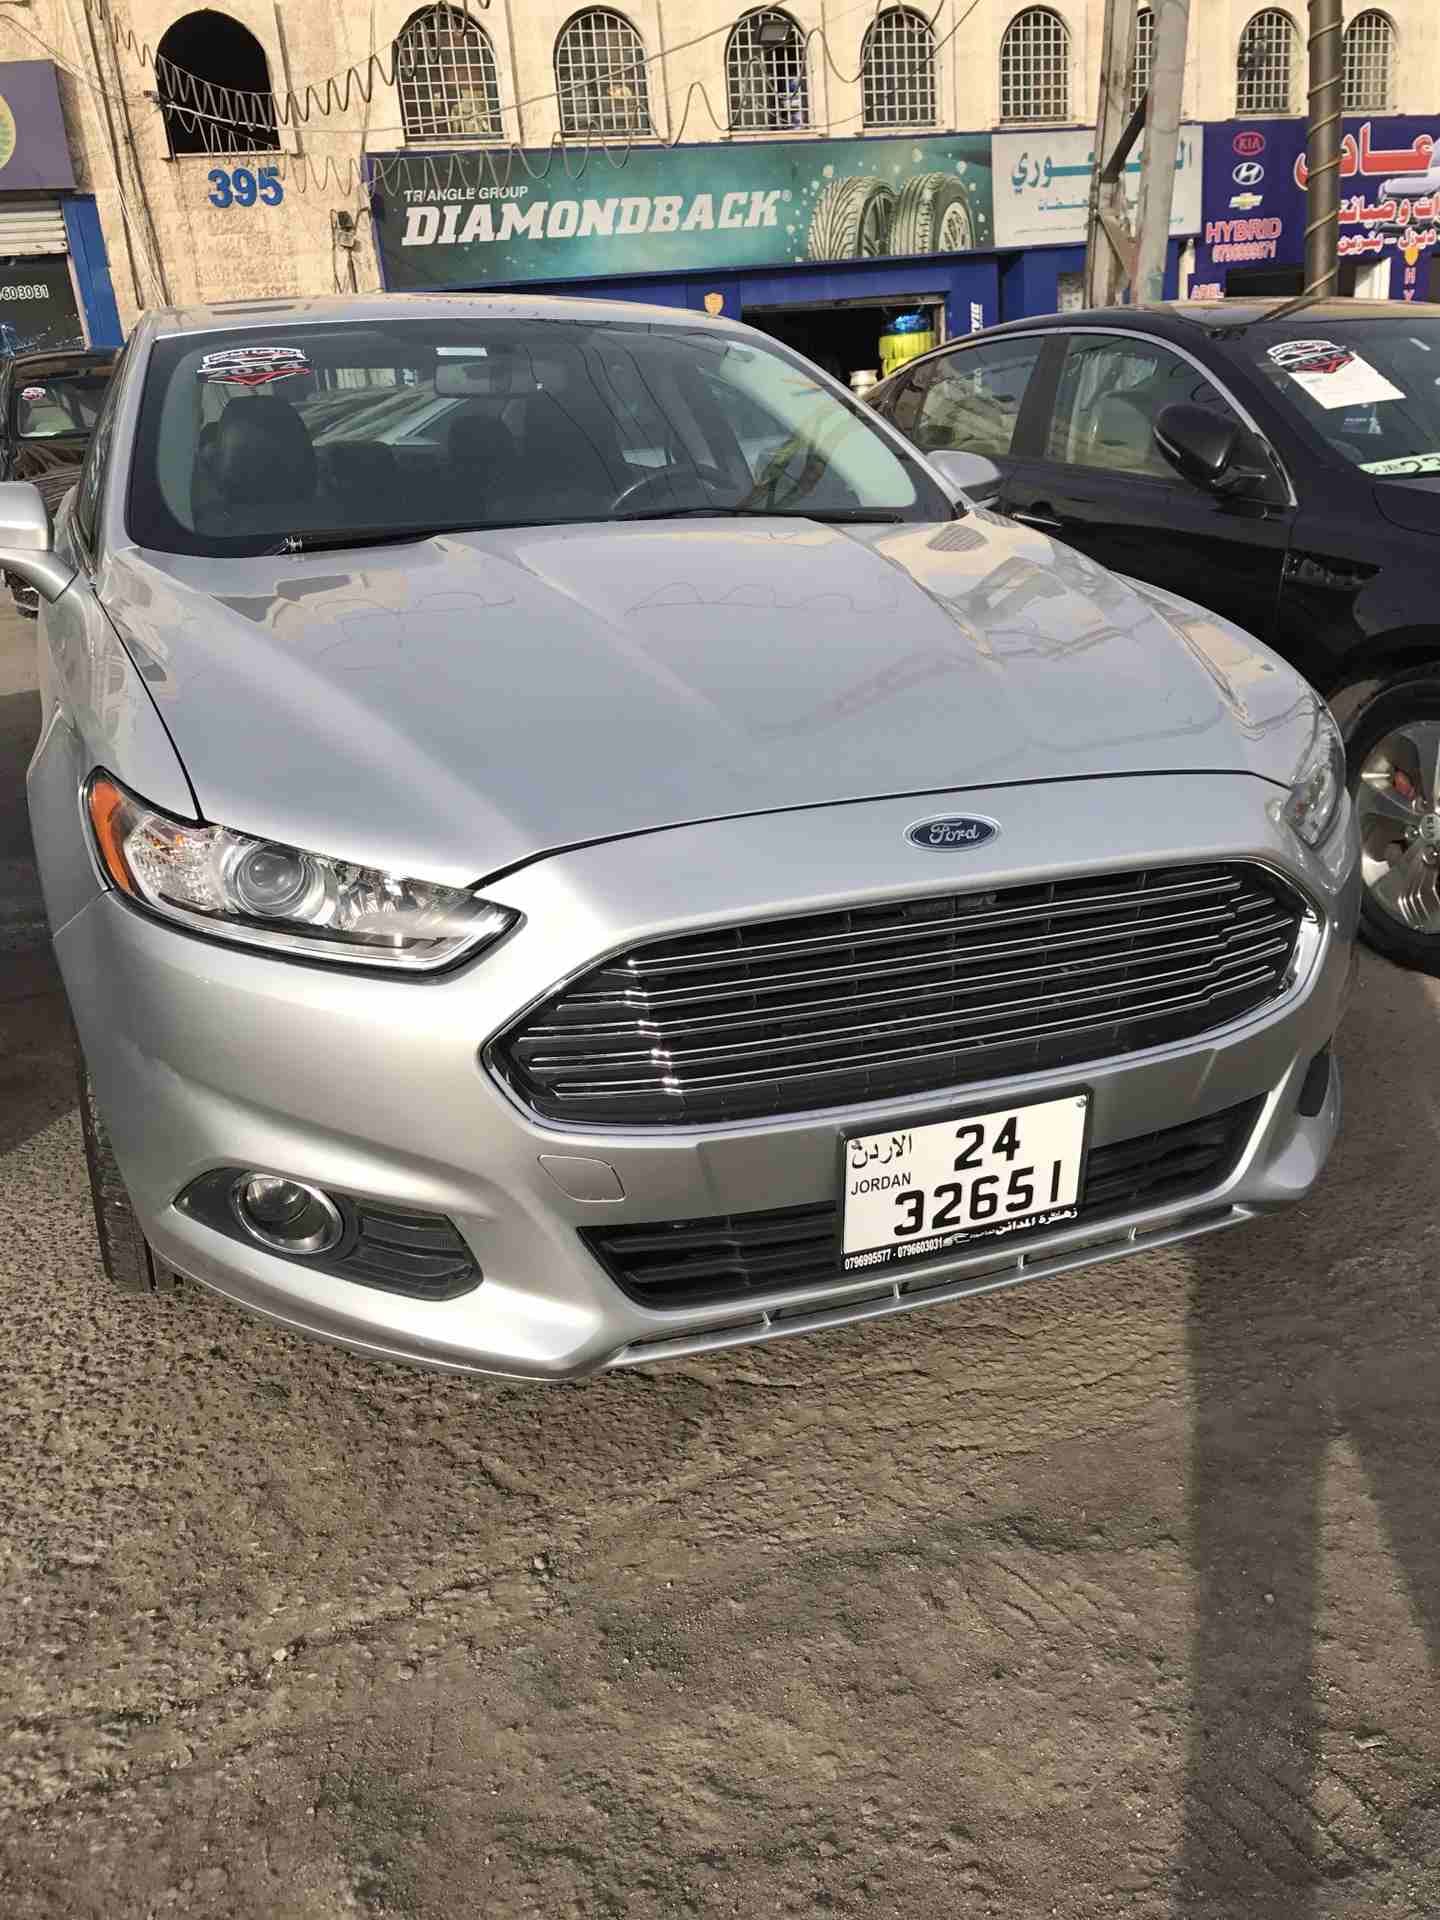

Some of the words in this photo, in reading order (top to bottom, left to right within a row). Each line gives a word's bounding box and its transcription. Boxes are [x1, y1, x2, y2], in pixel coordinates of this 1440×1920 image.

[1238, 136, 1262, 151] KIA
[207, 166, 285, 209] 395
[404, 187, 475, 202] TRIANGLE
[479, 185, 528, 200] GROUP
[401, 190, 781, 246] DIAMONDBACK
[1206, 217, 1282, 244] HYBRID
[929, 821, 980, 844] Ford
[954, 1116, 1021, 1172] 24
[851, 1172, 912, 1196] JORDAN
[893, 1159, 1062, 1237] 32651
